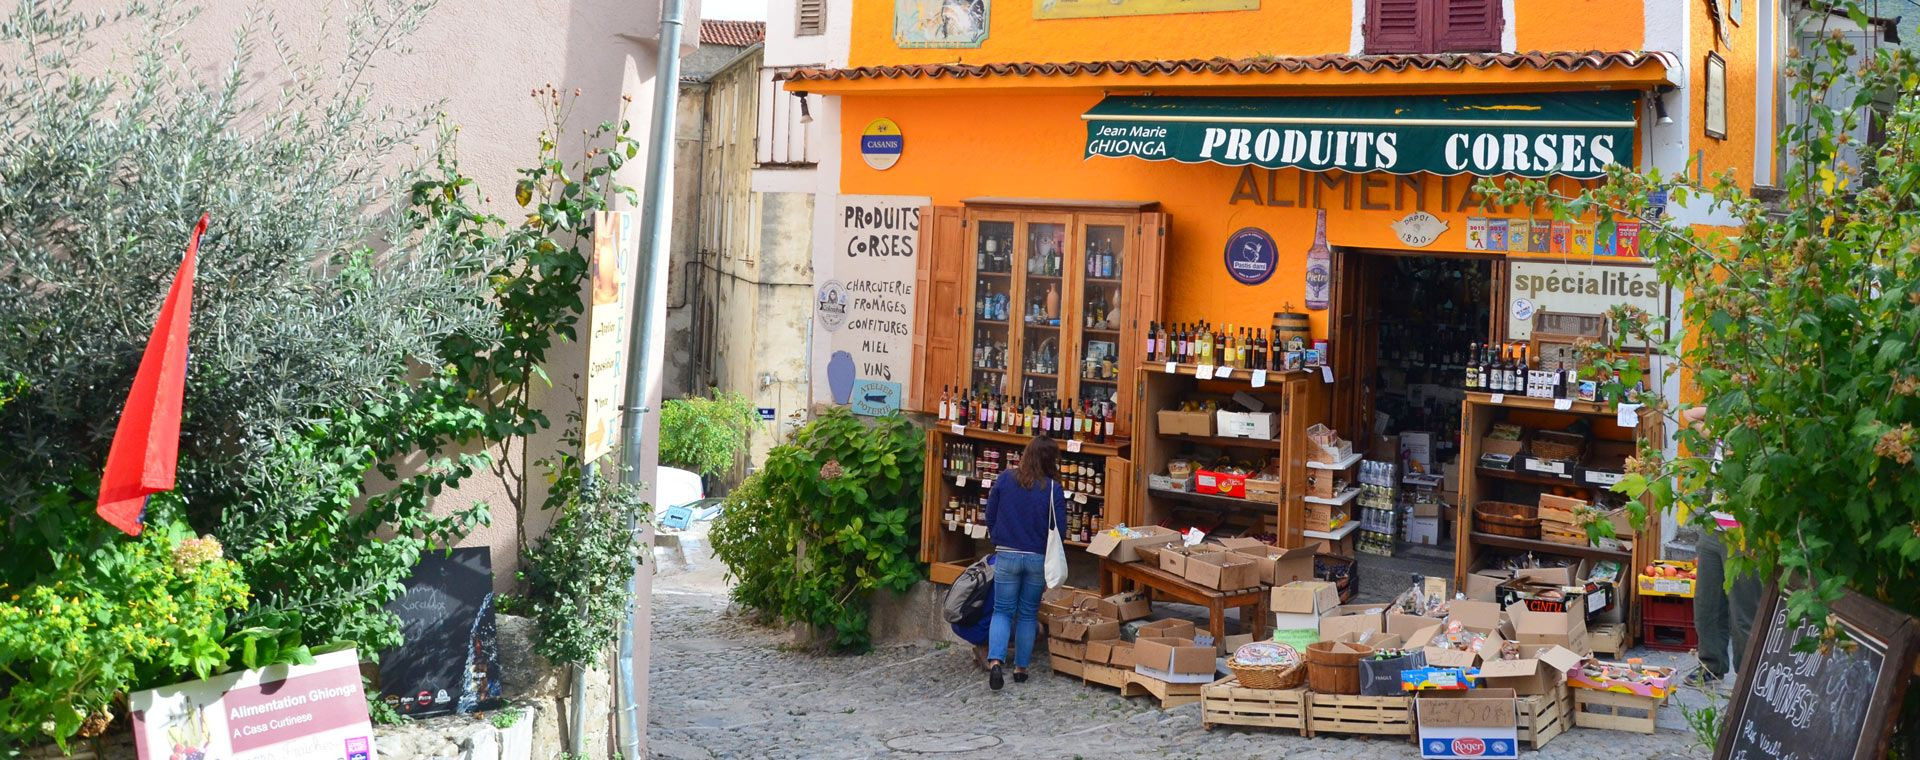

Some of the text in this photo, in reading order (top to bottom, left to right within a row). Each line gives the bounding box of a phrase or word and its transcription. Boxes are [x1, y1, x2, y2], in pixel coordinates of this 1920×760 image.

[1097, 125, 1167, 138] Jean Marie
[867, 140, 898, 149] CASANIS
[1088, 139, 1167, 156] GHIONGA
[1200, 127, 1616, 173] PRODUITS CORSES
[845, 206, 920, 231] PRODUITS
[847, 234, 913, 258] CORSES
[846, 279, 912, 296] CHARCUTERIE
[1515, 268, 1659, 300] spécialités
[853, 298, 907, 315] FROMAGES
[848, 318, 908, 336] CONFITURES
[862, 340, 889, 354] MIEL
[863, 362, 891, 381] VINS
[860, 384, 894, 397] ATELIER
[230, 681, 357, 720] Alimentation Ghionga
[233, 712, 313, 739] A Casa Curtinese
[1454, 740, 1484, 754] Roger
